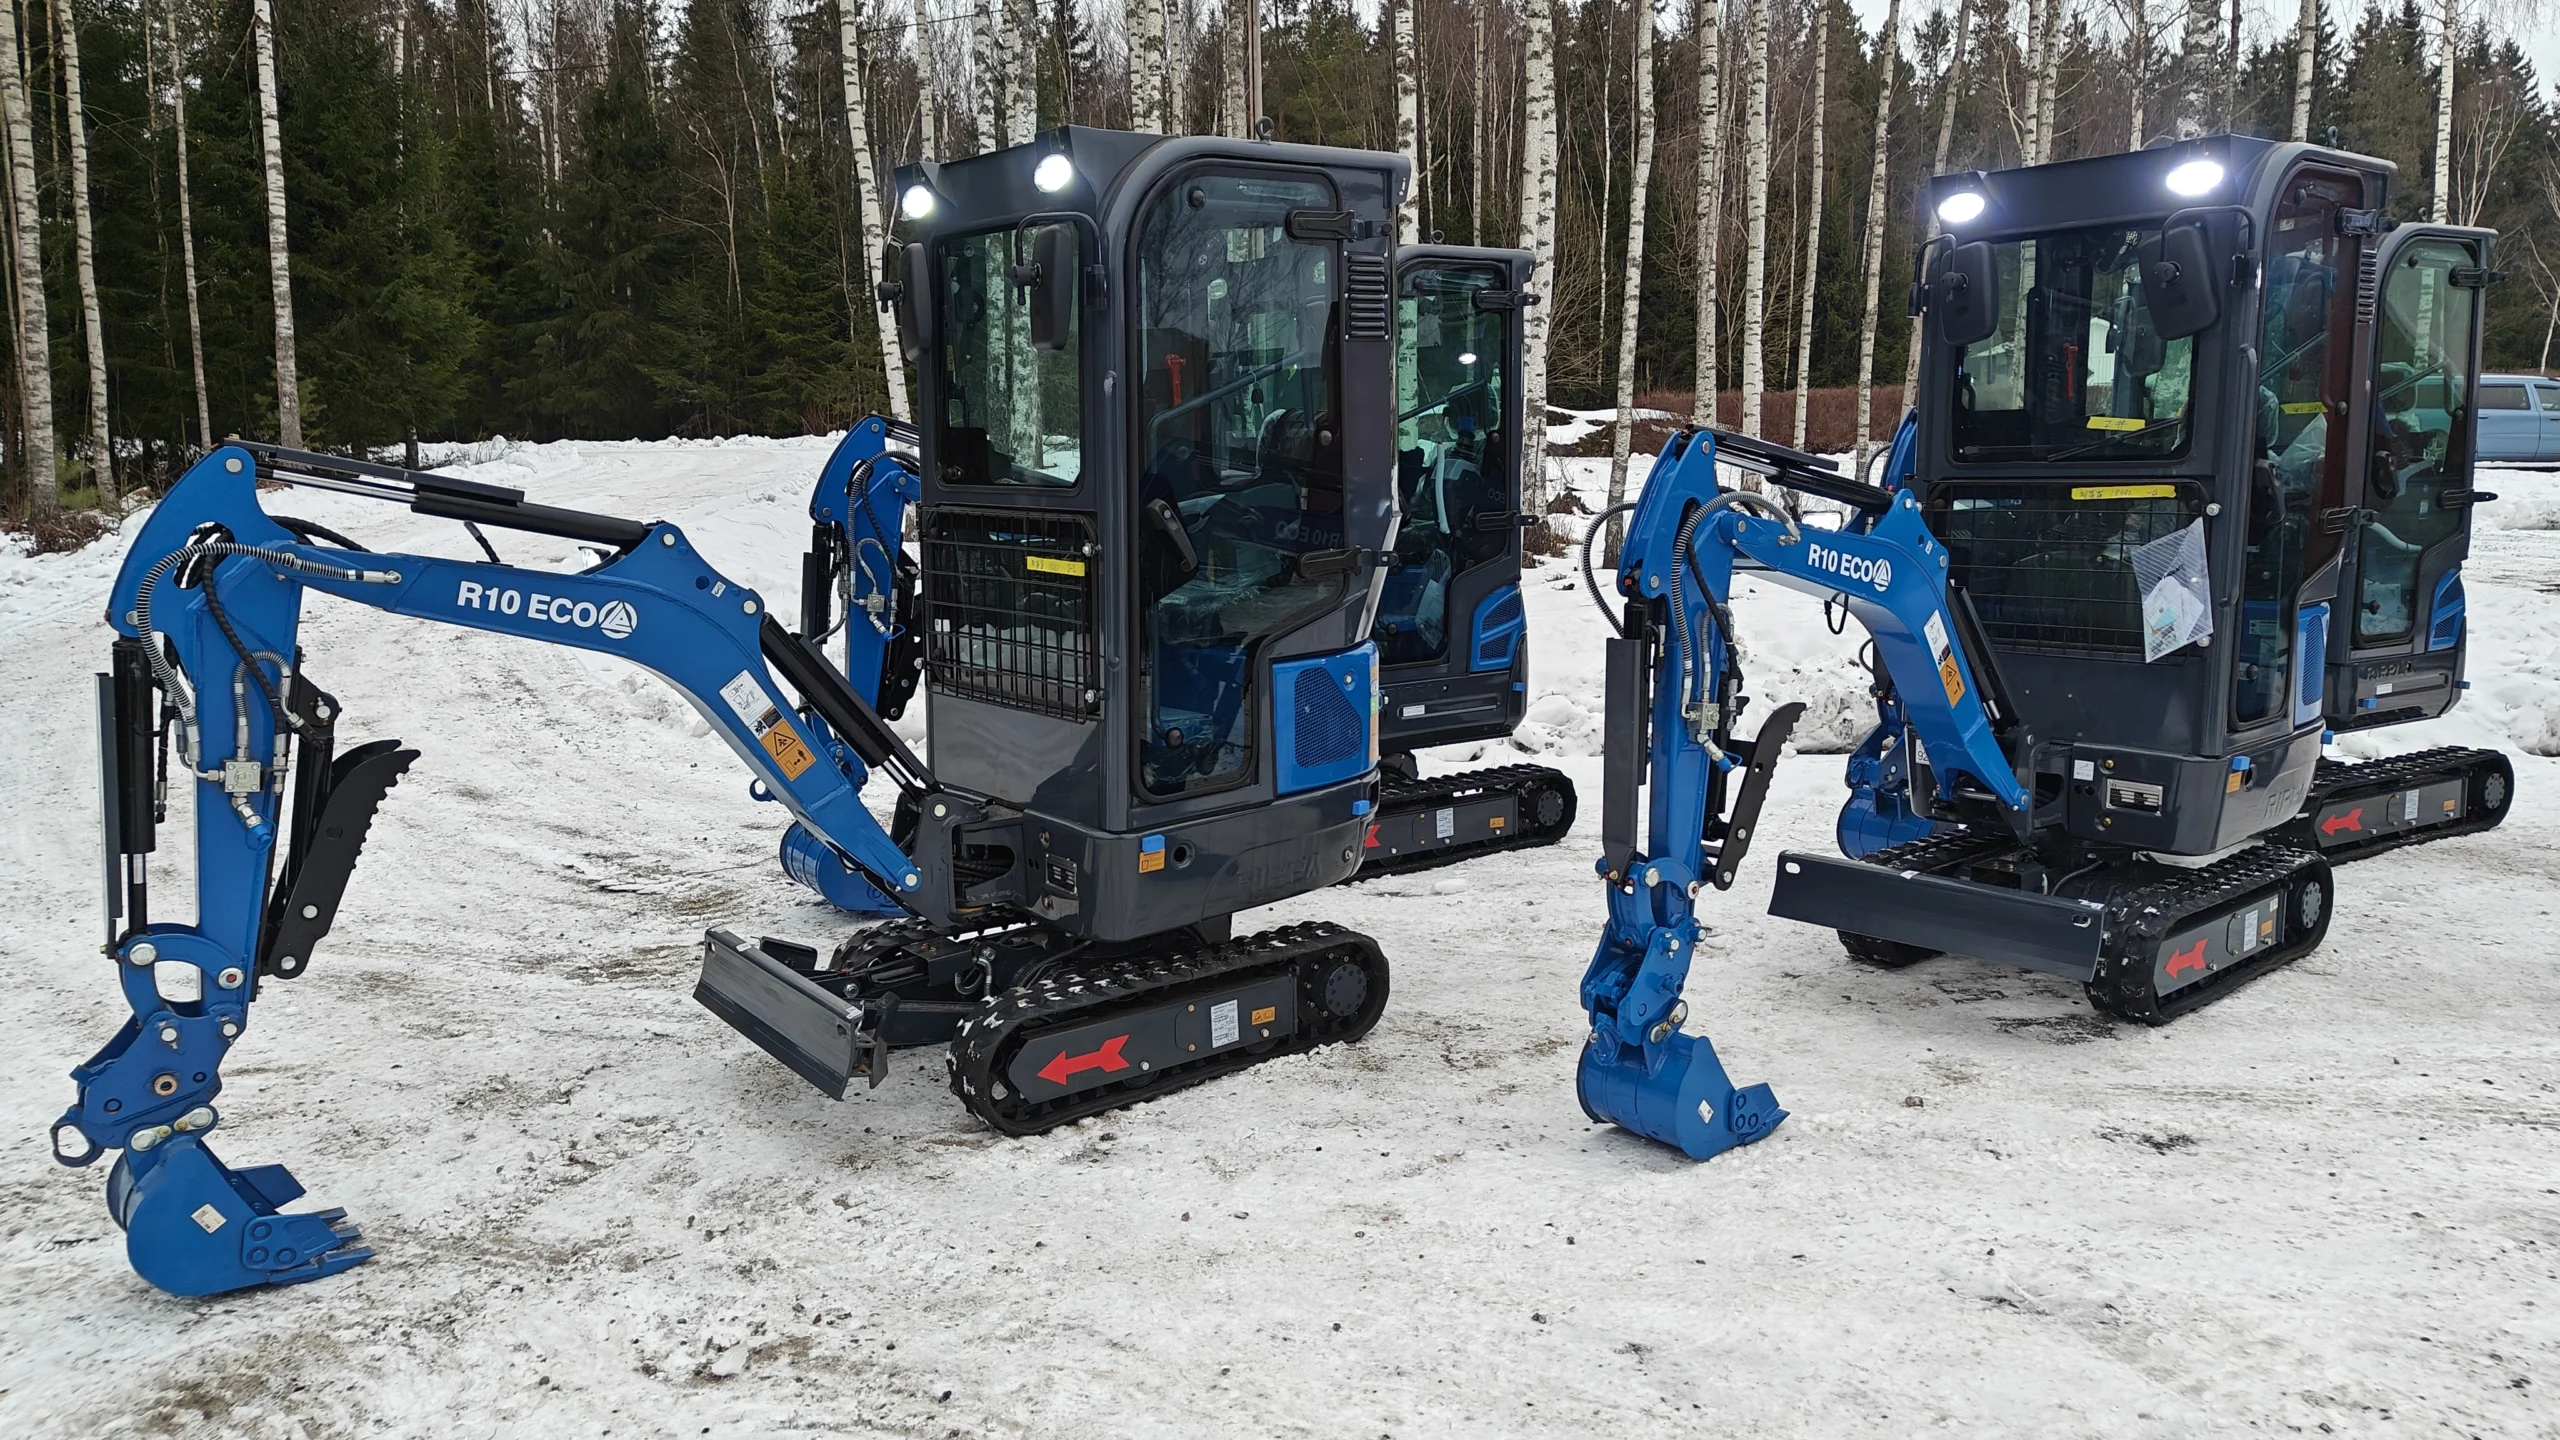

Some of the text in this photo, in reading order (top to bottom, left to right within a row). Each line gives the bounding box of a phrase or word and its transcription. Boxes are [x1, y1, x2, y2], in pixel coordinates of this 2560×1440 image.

[1808, 543, 1873, 583] R10 ECO
[457, 580, 598, 628] R10 ECO
